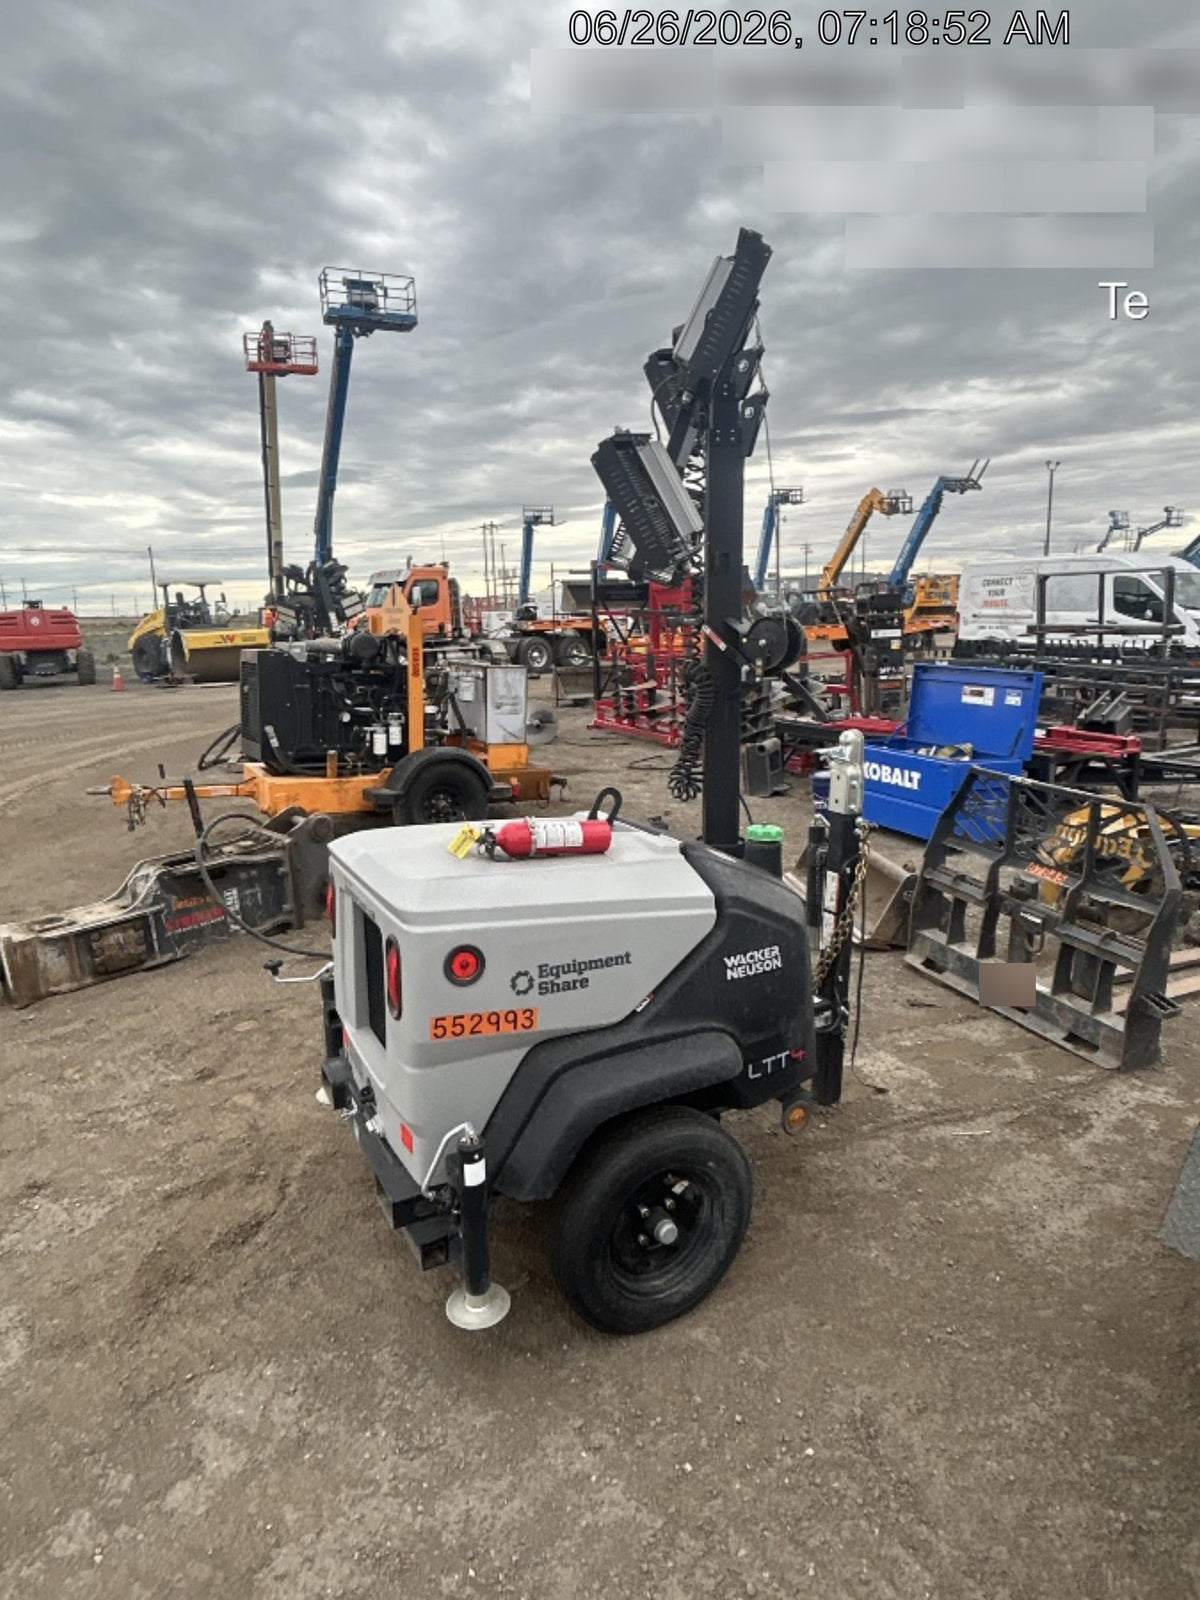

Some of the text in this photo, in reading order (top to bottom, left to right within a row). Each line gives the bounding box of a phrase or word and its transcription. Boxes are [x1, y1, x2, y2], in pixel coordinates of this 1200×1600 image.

[537, 951, 632, 980] Equipment
[723, 945, 781, 968] WACKER
[726, 956, 782, 980] NEUSON
[538, 976, 589, 996] Share
[432, 1008, 535, 1039] 552993
[748, 1047, 806, 1080] LTT4
